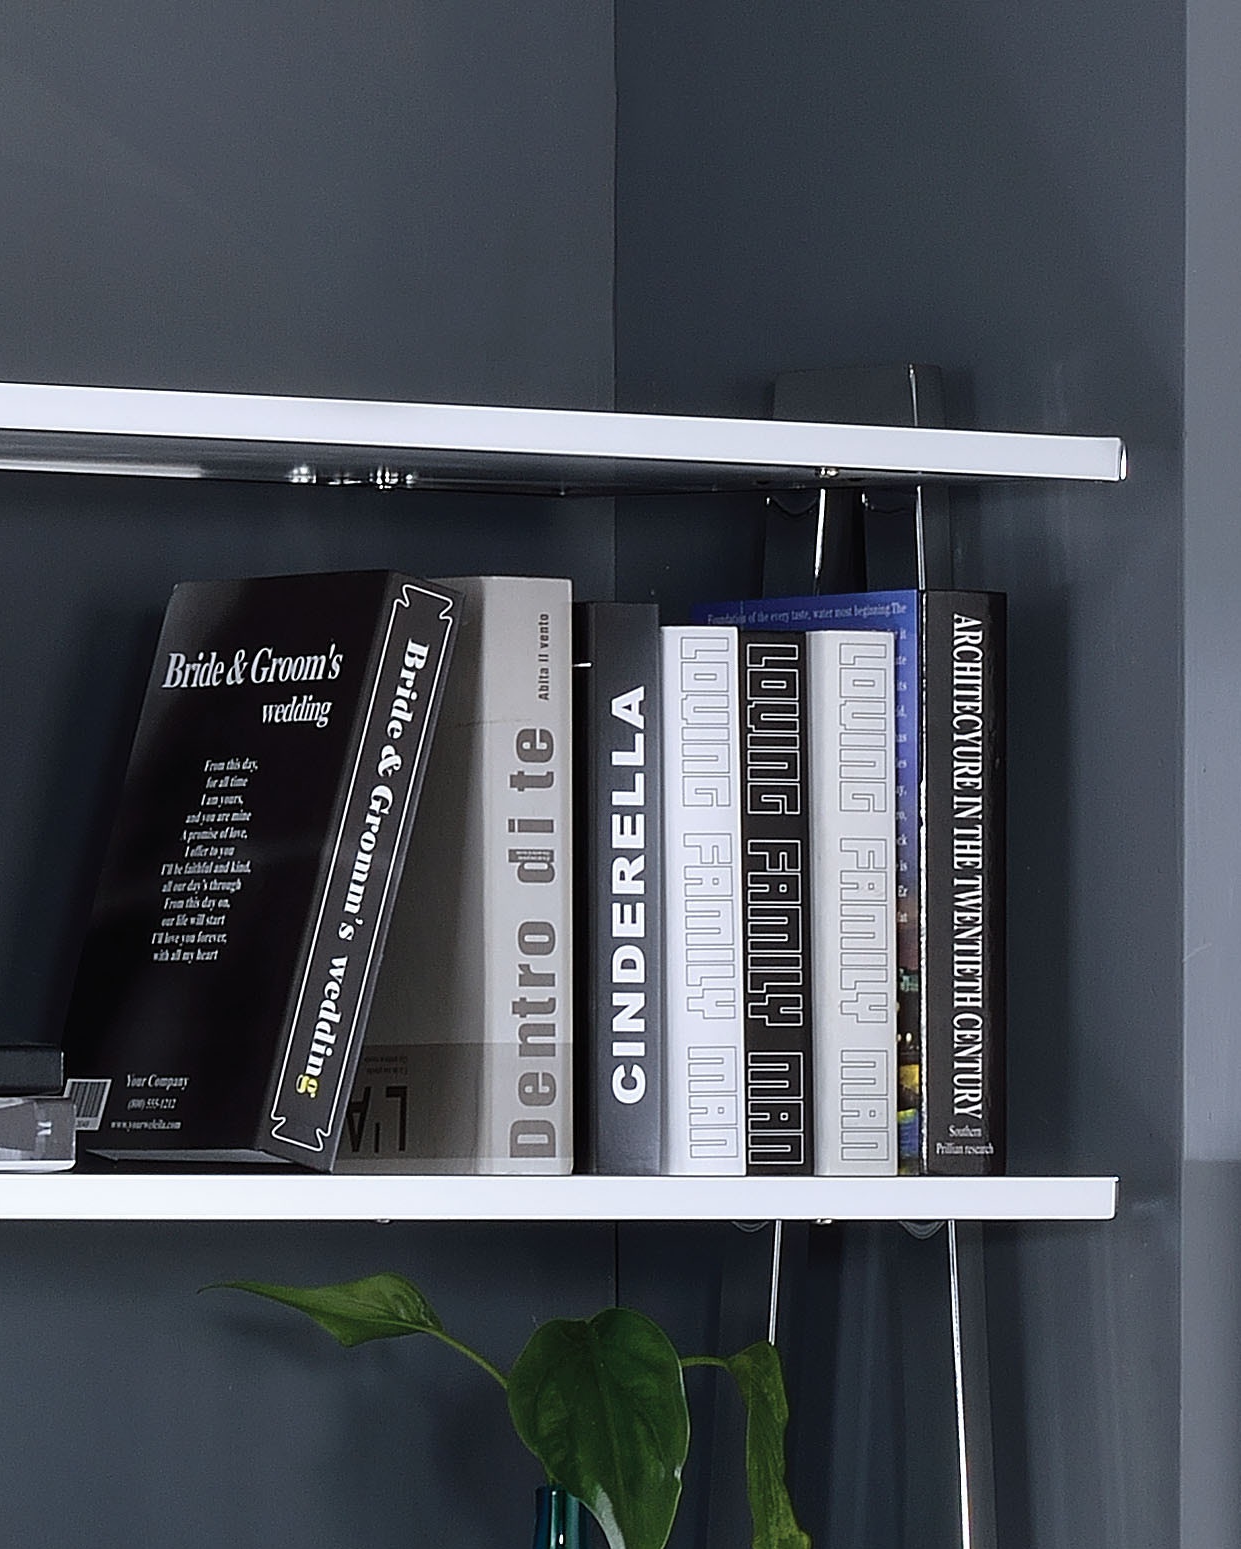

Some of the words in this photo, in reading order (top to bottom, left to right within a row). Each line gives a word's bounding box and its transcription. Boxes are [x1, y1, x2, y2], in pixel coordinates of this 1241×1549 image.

[161, 650, 225, 688] Bride
[226, 649, 249, 686] &
[250, 643, 344, 684] Groom's
[386, 638, 431, 740] Bride
[953, 613, 983, 790] ARCHITECYURE
[261, 694, 333, 728] wedding
[204, 759, 225, 772] From
[226, 758, 240, 771] this
[377, 744, 403, 778] &
[509, 728, 555, 792] te
[206, 776, 218, 789] for
[219, 776, 230, 788] all
[230, 775, 248, 787] time
[206, 796, 218, 805] am
[953, 795, 983, 819] IN
[185, 811, 201, 824] and
[200, 813, 216, 826] you
[217, 813, 230, 822] are
[231, 809, 252, 822] mine
[187, 827, 219, 844] promise
[219, 827, 230, 839] of
[953, 824, 983, 870] THE
[190, 844, 209, 857] offer
[209, 846, 218, 857] to
[218, 847, 235, 859] you
[338, 784, 395, 941] Gromm's
[508, 819, 555, 883] di
[173, 863, 184, 875] be
[184, 861, 214, 875] faithful
[213, 861, 231, 874] and
[162, 880, 173, 892] all
[209, 878, 242, 894] through
[611, 685, 646, 1104] CINDERELLA
[164, 897, 185, 910] From
[186, 896, 200, 909] this
[201, 896, 217, 911] day
[206, 915, 226, 926] start
[164, 932, 180, 944] love
[179, 934, 196, 947] you
[953, 875, 983, 1008] TWENTIETH
[171, 949, 182, 961] all
[182, 951, 196, 964] my
[196, 948, 219, 961] heart
[295, 956, 349, 1099] wedding
[509, 921, 557, 1158] Dentro
[952, 1012, 983, 1119] CENTURY
[126, 1074, 147, 1088] Your
[148, 1074, 189, 1091] Company
